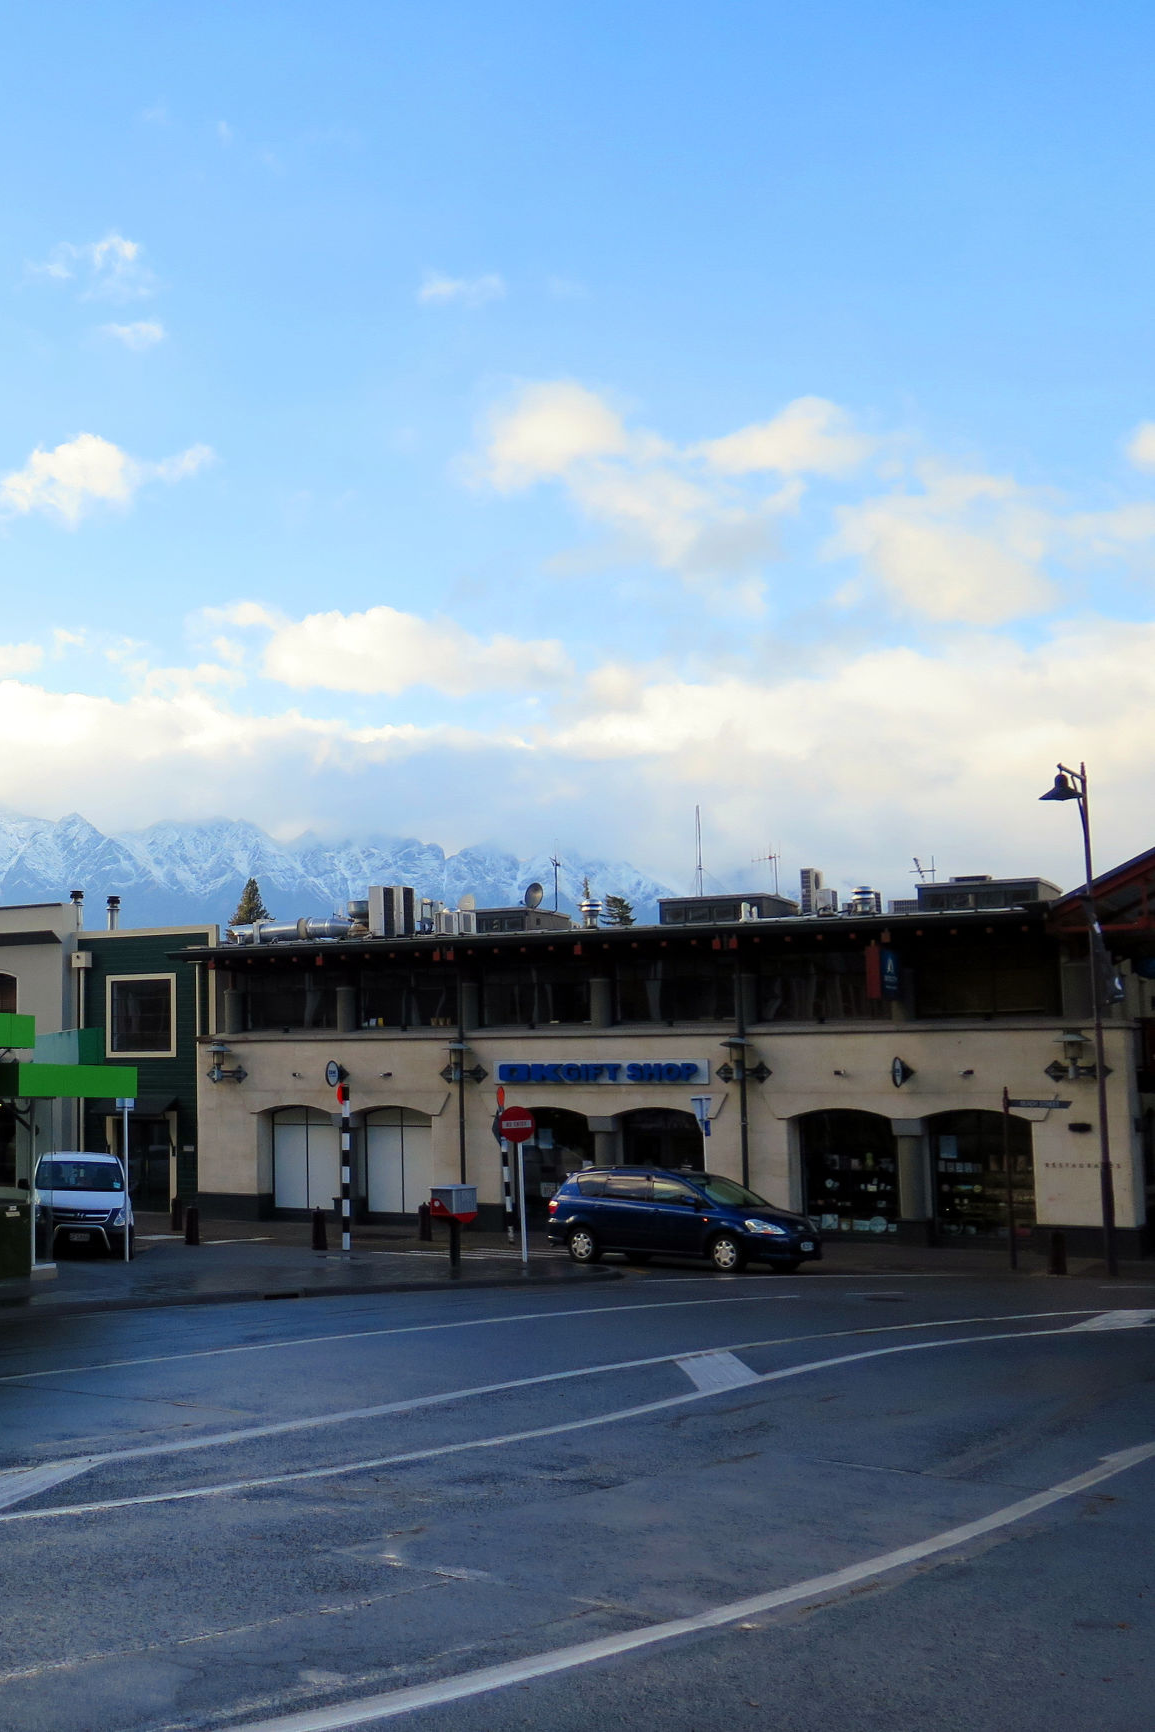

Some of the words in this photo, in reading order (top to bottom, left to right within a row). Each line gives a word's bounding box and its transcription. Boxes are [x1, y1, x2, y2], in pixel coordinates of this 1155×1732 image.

[499, 1063, 563, 1082] OK
[562, 1063, 621, 1082] GIFT
[627, 1062, 698, 1082] SHOP
